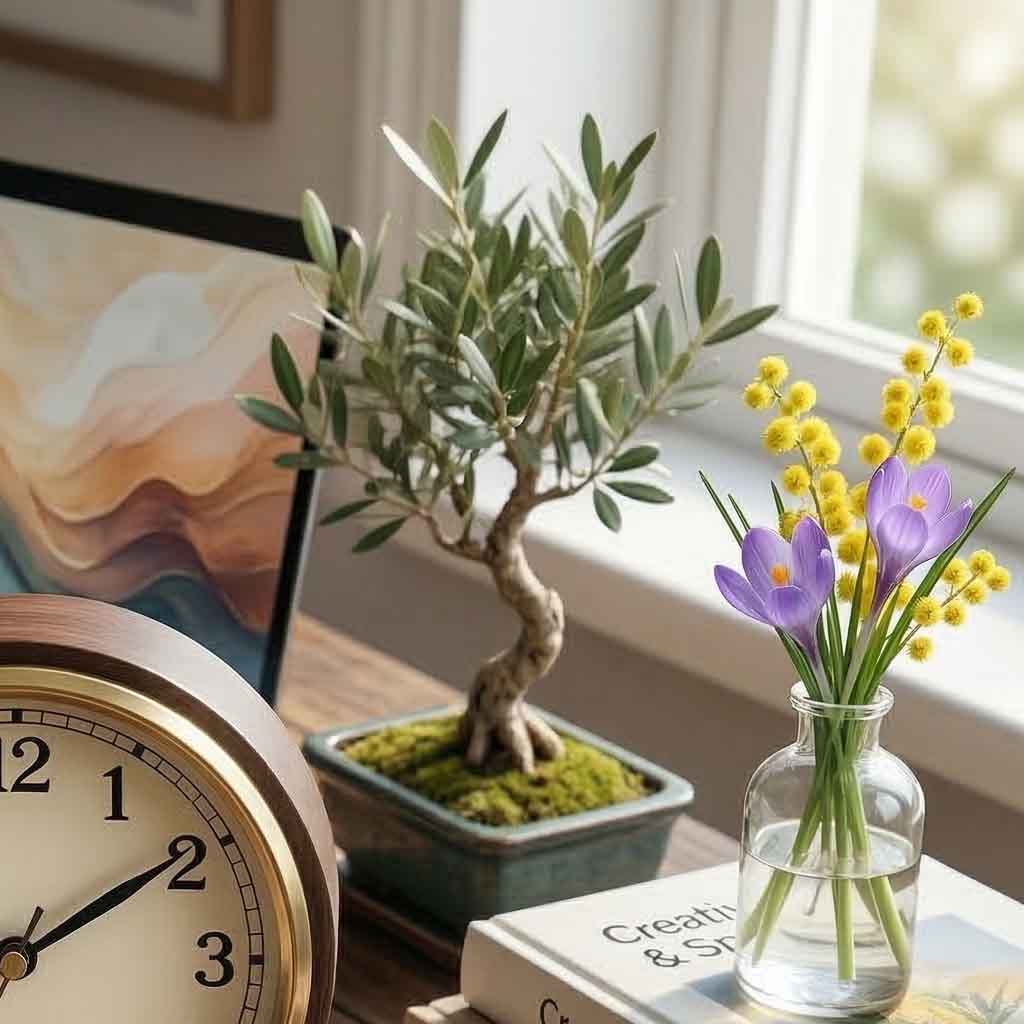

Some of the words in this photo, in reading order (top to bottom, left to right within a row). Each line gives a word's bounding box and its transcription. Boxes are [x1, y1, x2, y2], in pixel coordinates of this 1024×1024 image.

[102, 766, 129, 820] 1
[167, 835, 207, 890] 2
[194, 931, 235, 987] 3
[644, 949, 689, 968] &
